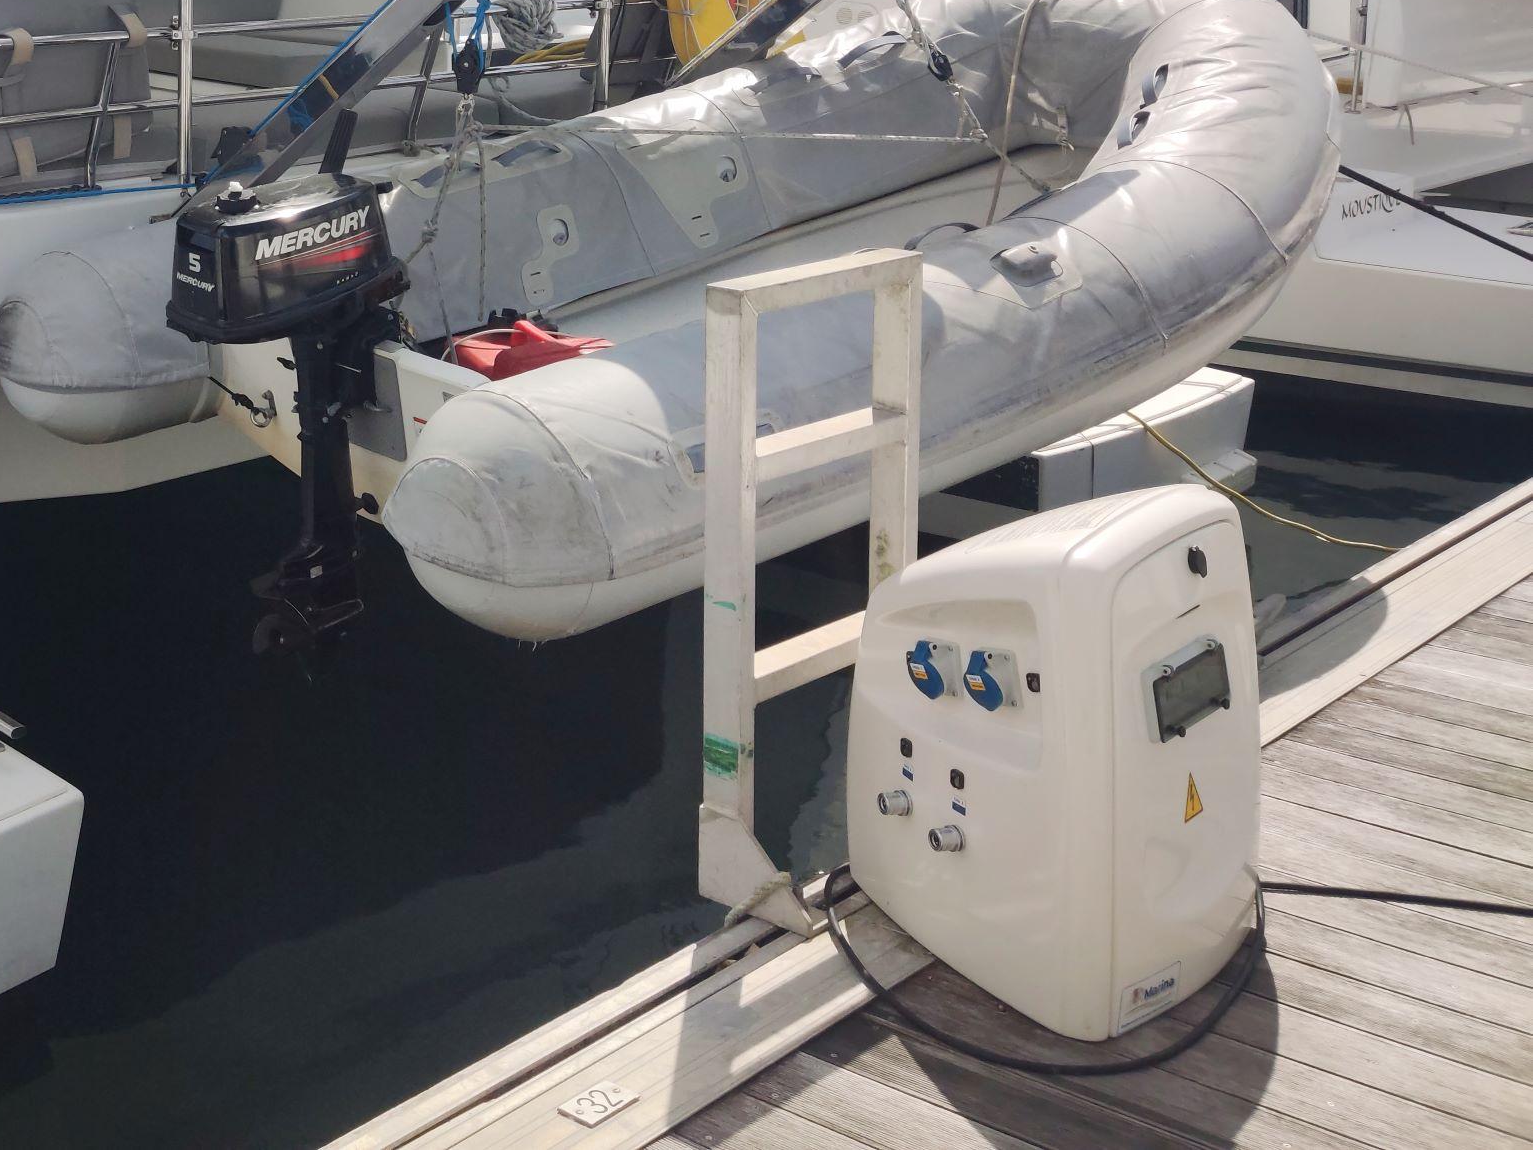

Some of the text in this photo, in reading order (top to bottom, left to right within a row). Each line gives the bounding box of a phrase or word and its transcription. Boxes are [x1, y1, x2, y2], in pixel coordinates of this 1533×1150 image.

[254, 205, 370, 261] MERCURY
[187, 252, 201, 273] 5
[176, 271, 216, 293] MERCURY
[575, 1088, 625, 1115] 32
